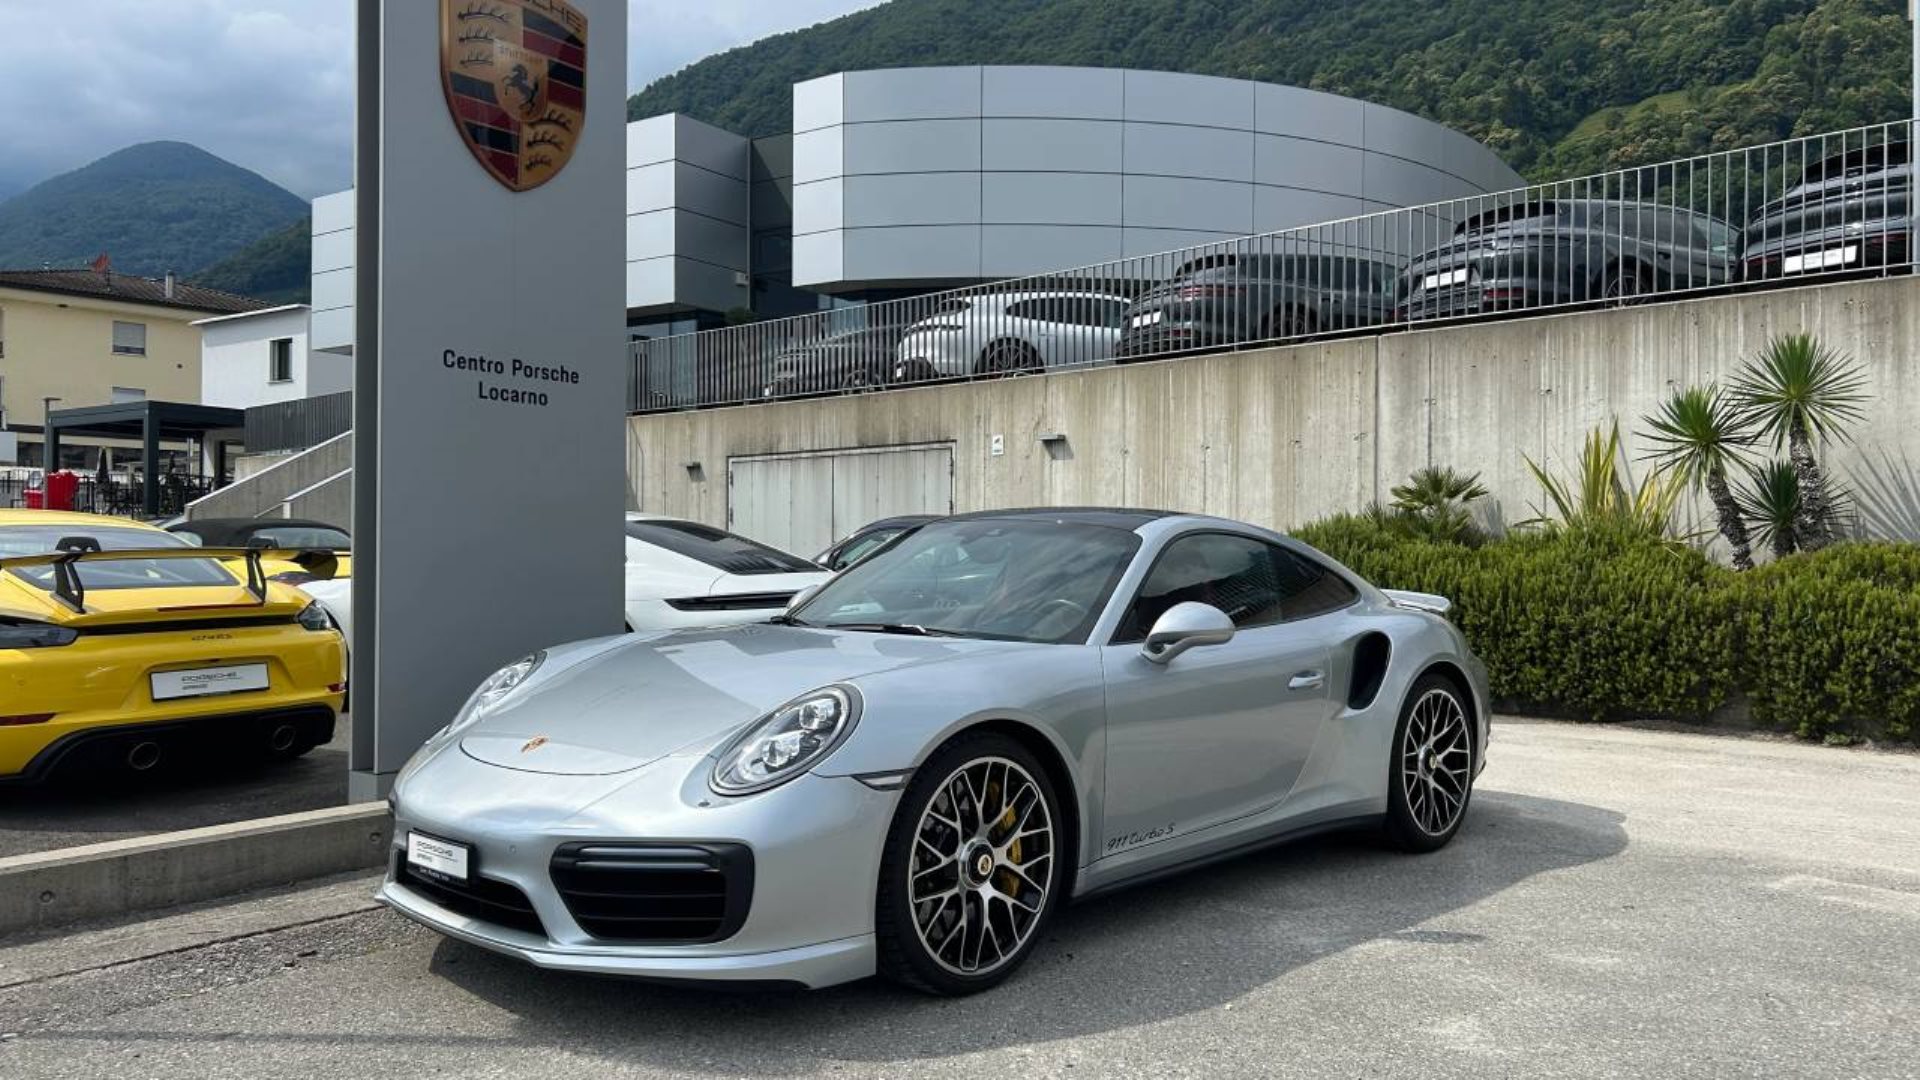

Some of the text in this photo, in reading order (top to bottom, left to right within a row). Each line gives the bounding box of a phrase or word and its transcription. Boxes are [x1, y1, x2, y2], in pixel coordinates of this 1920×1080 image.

[443, 349, 580, 384] Centro Porsche
[478, 381, 549, 406] Locarno
[181, 671, 237, 681] PORSCHE
[1107, 834, 1128, 851] 911
